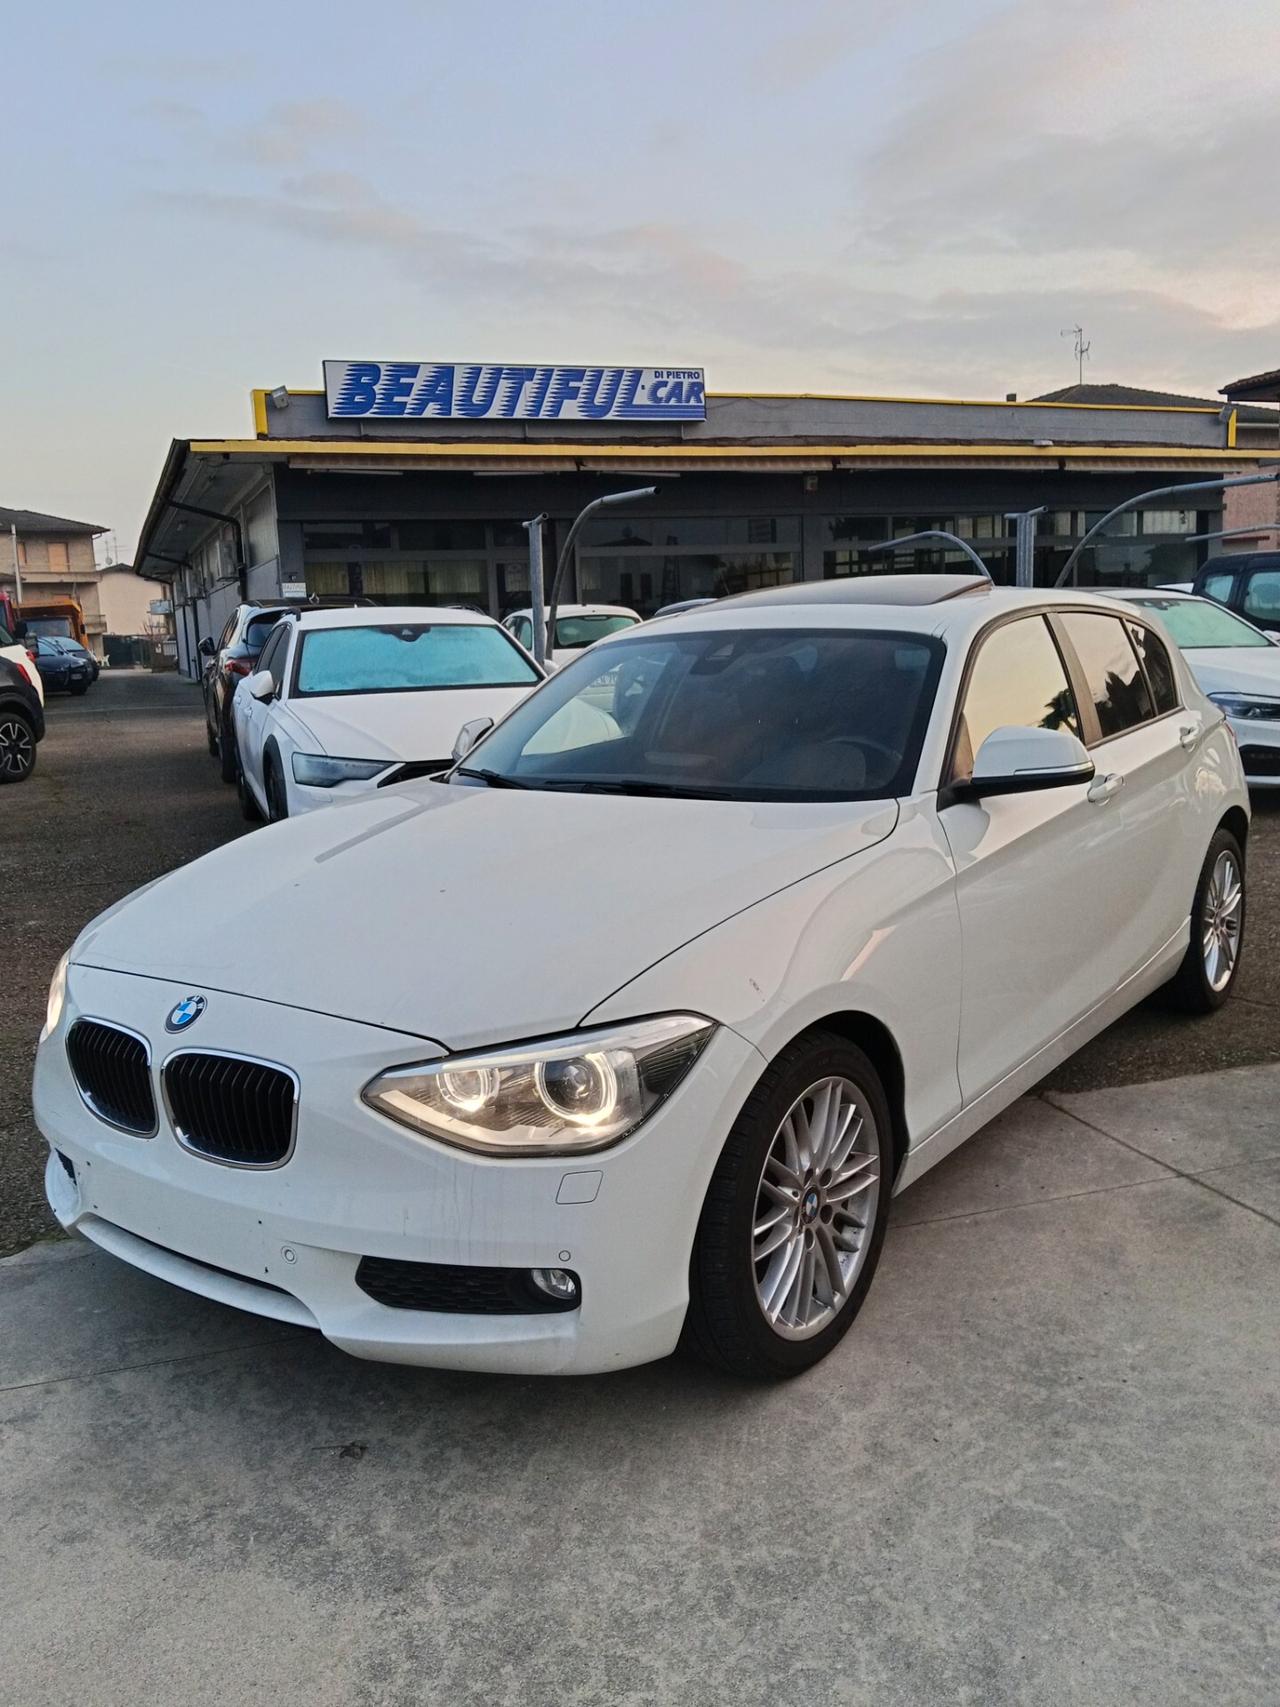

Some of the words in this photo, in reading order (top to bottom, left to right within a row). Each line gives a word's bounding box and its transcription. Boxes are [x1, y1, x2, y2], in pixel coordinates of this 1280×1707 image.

[331, 363, 645, 418] BEAUTIFUL
[648, 381, 704, 404] CAR
[654, 371, 664, 379] DI
[666, 371, 700, 379] PIETRO
